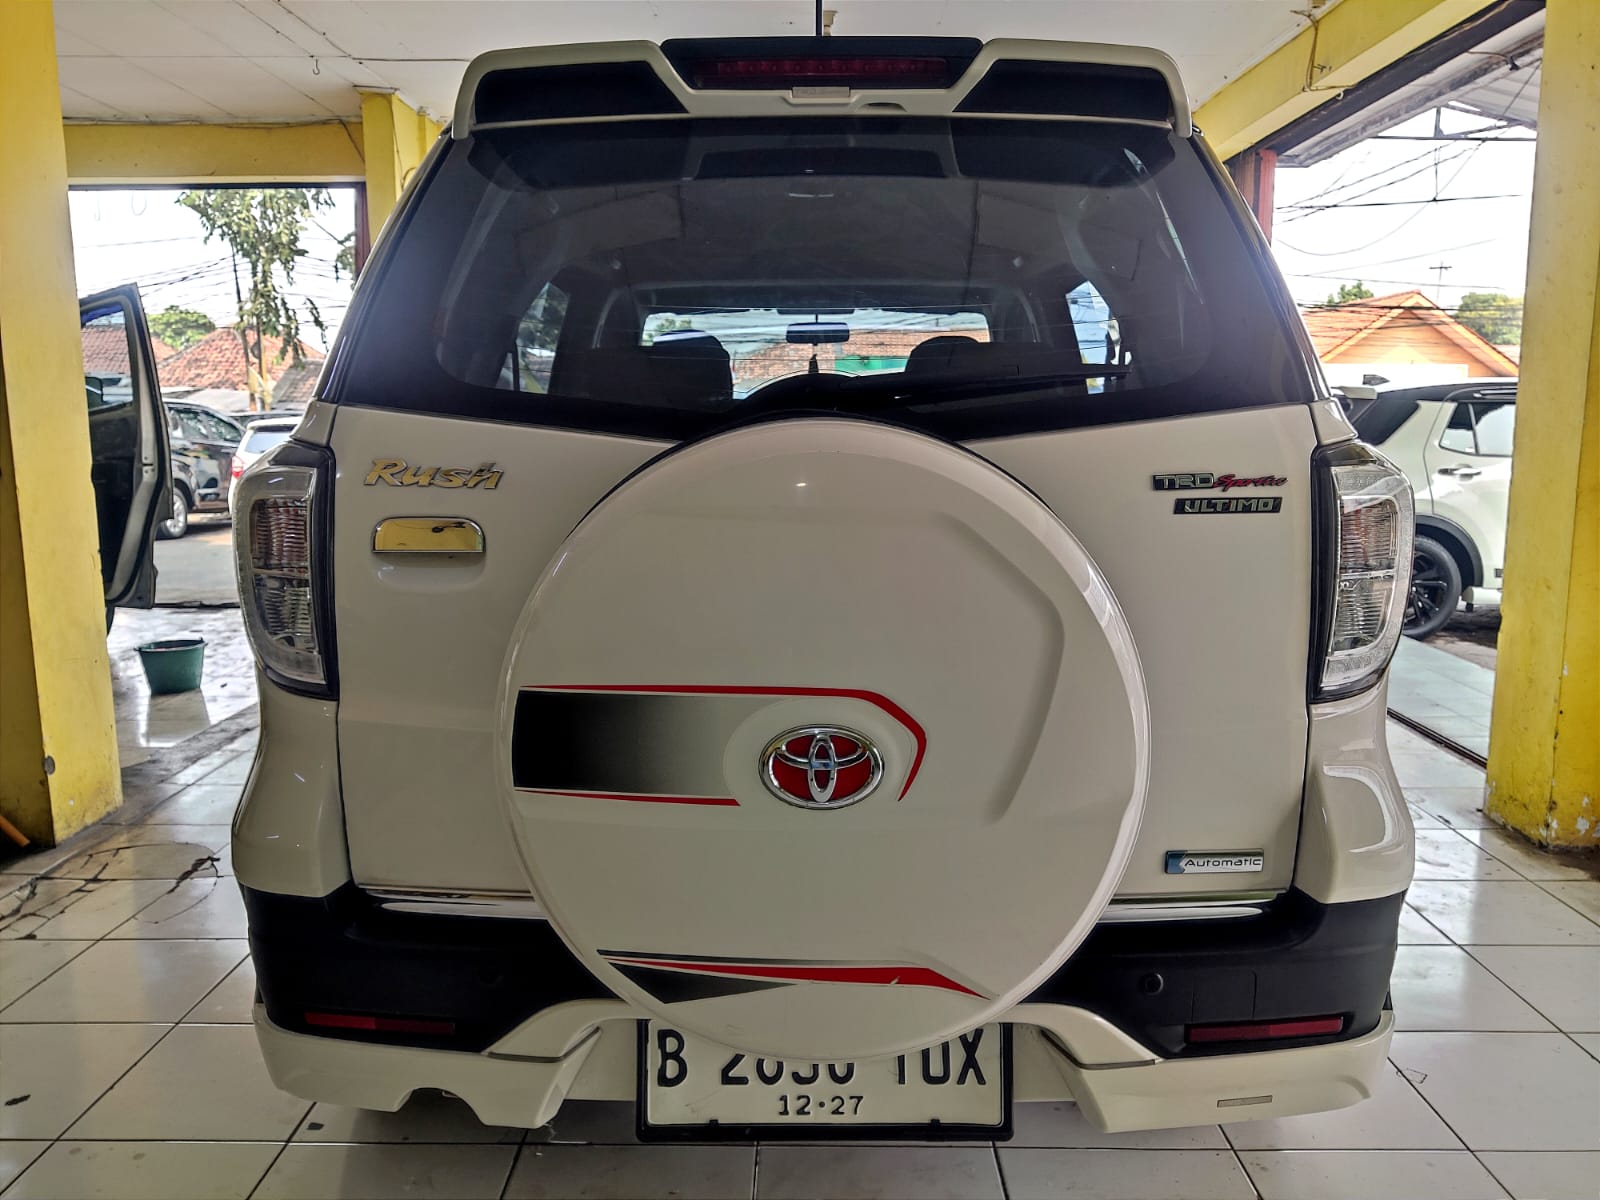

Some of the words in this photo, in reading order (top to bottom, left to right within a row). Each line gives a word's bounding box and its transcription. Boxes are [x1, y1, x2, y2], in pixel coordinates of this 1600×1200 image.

[364, 458, 504, 489] Rush
[1155, 473, 1214, 489] TRD
[1184, 498, 1274, 512] ULTIMO
[1184, 858, 1262, 867] Automatic
[657, 1029, 688, 1087] B
